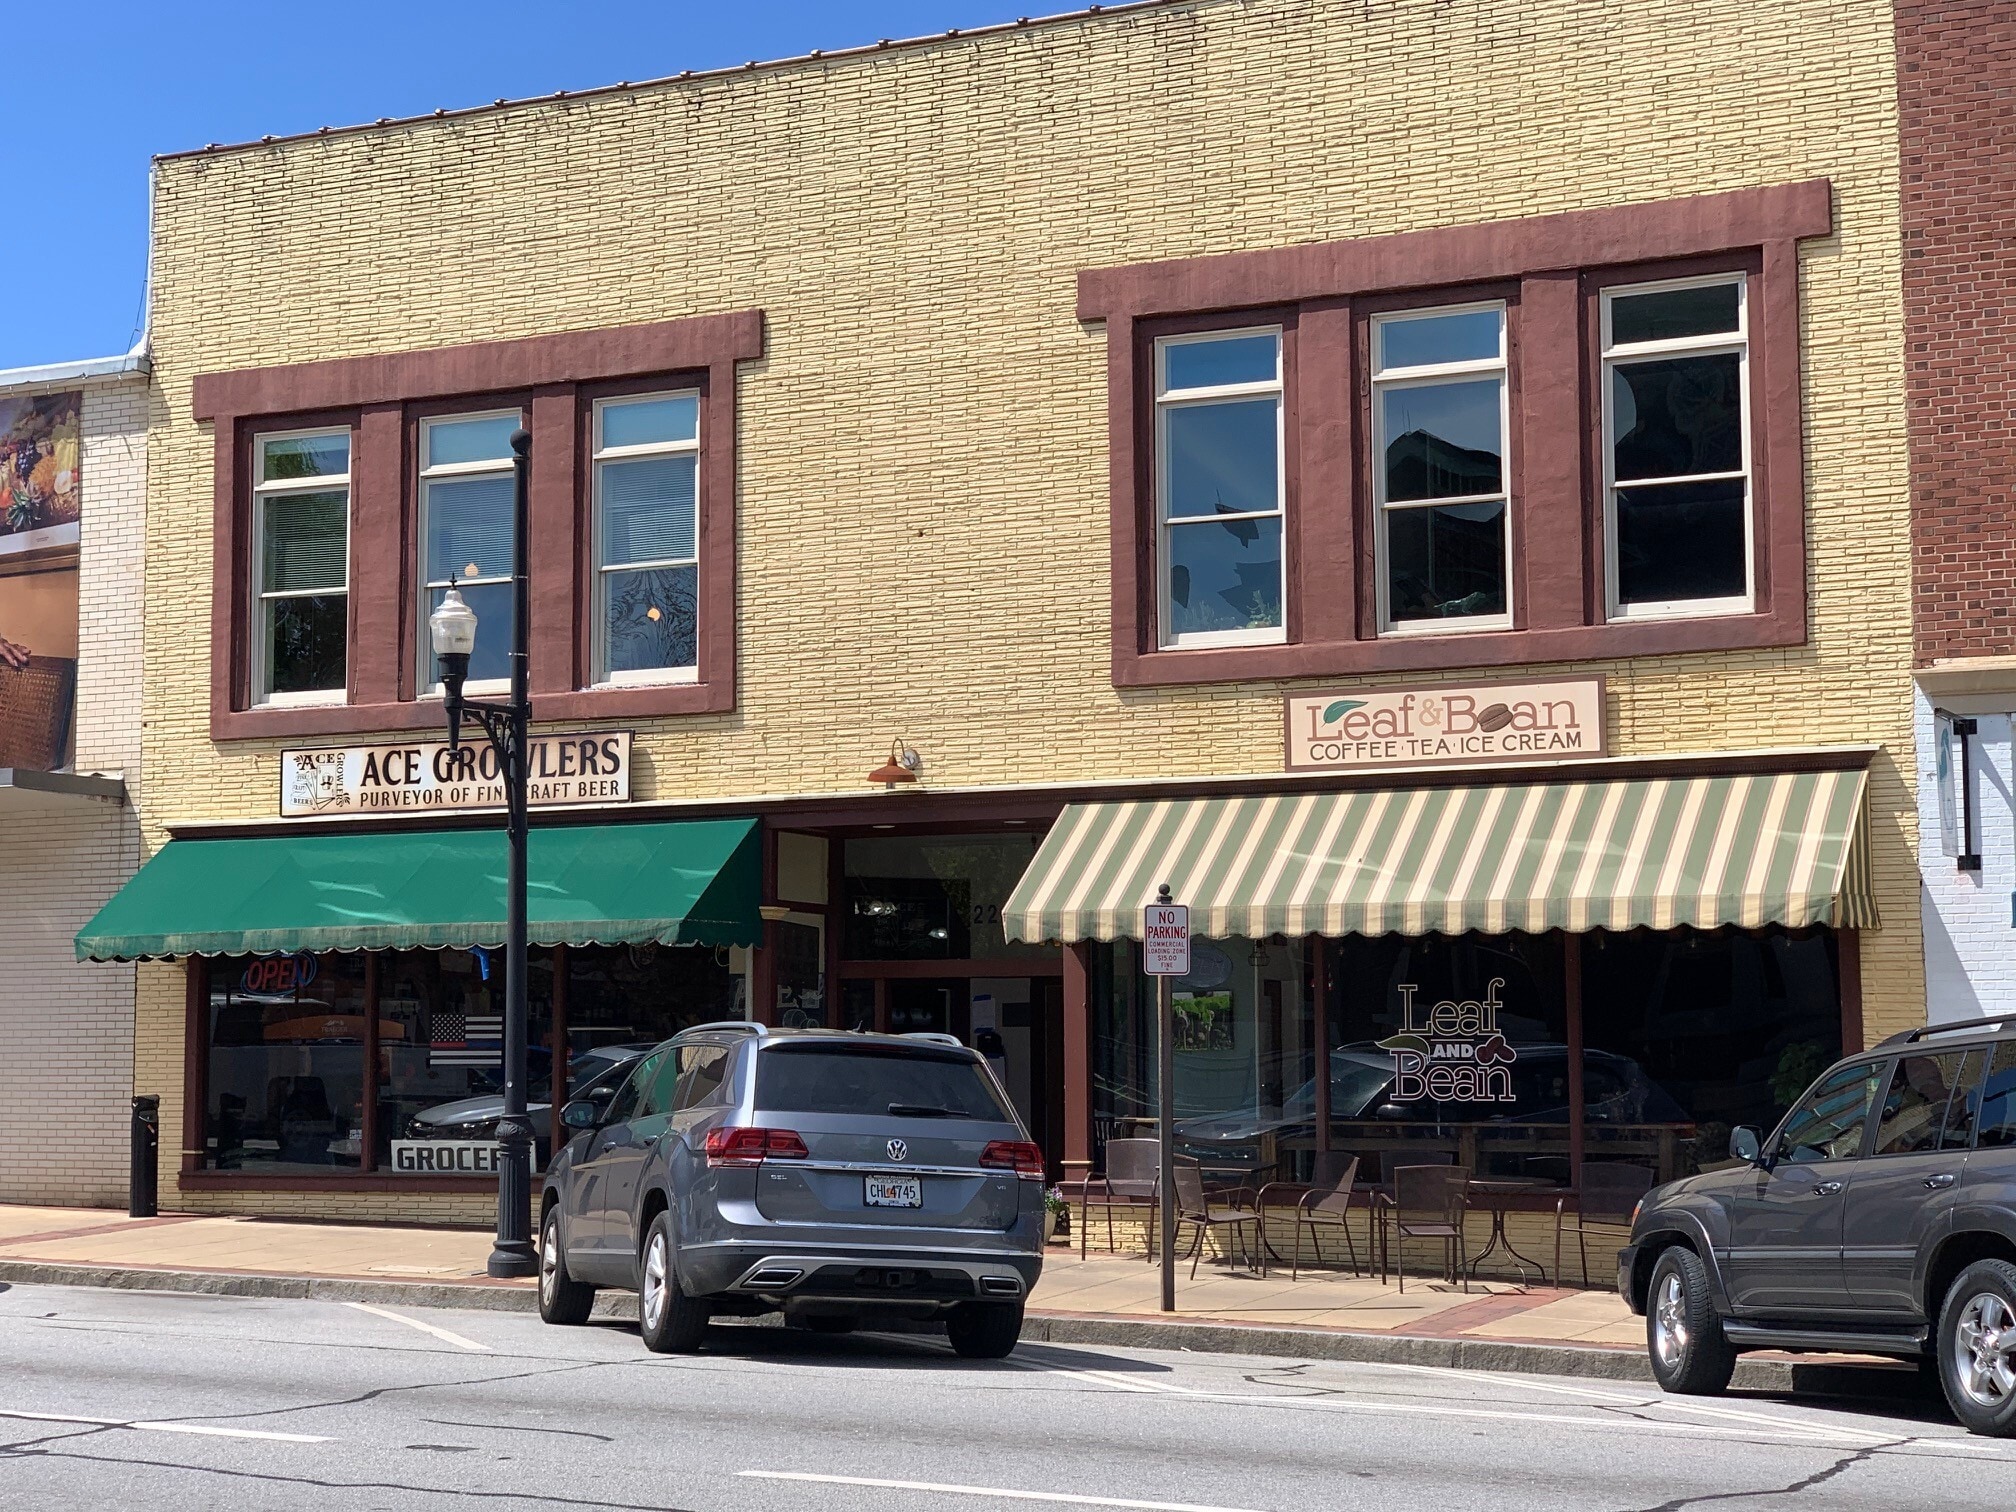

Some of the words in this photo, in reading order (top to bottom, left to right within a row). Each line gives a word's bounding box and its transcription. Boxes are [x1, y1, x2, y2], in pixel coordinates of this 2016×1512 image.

[1306, 694, 1414, 742] Leaf
[1309, 739, 1397, 761] COFFEE
[1406, 738, 1451, 756] TEA
[1460, 735, 1495, 754] ICE
[1501, 731, 1582, 750] CREAM
[300, 753, 335, 771] ACE
[360, 748, 423, 787] ACE
[359, 788, 443, 808] PURVEYOR
[450, 787, 470, 803] OF
[477, 785, 504, 801] FIN
[526, 780, 570, 799] RAFT
[577, 779, 620, 797] BEER
[1158, 911, 1175, 924] NO
[1148, 926, 1186, 939] PARKING
[246, 959, 309, 991] OPEN
[1397, 977, 1506, 1036] Leaf
[1432, 1043, 1476, 1058] AND
[1389, 1049, 1516, 1102] Bean
[397, 1147, 501, 1171] GROCER
